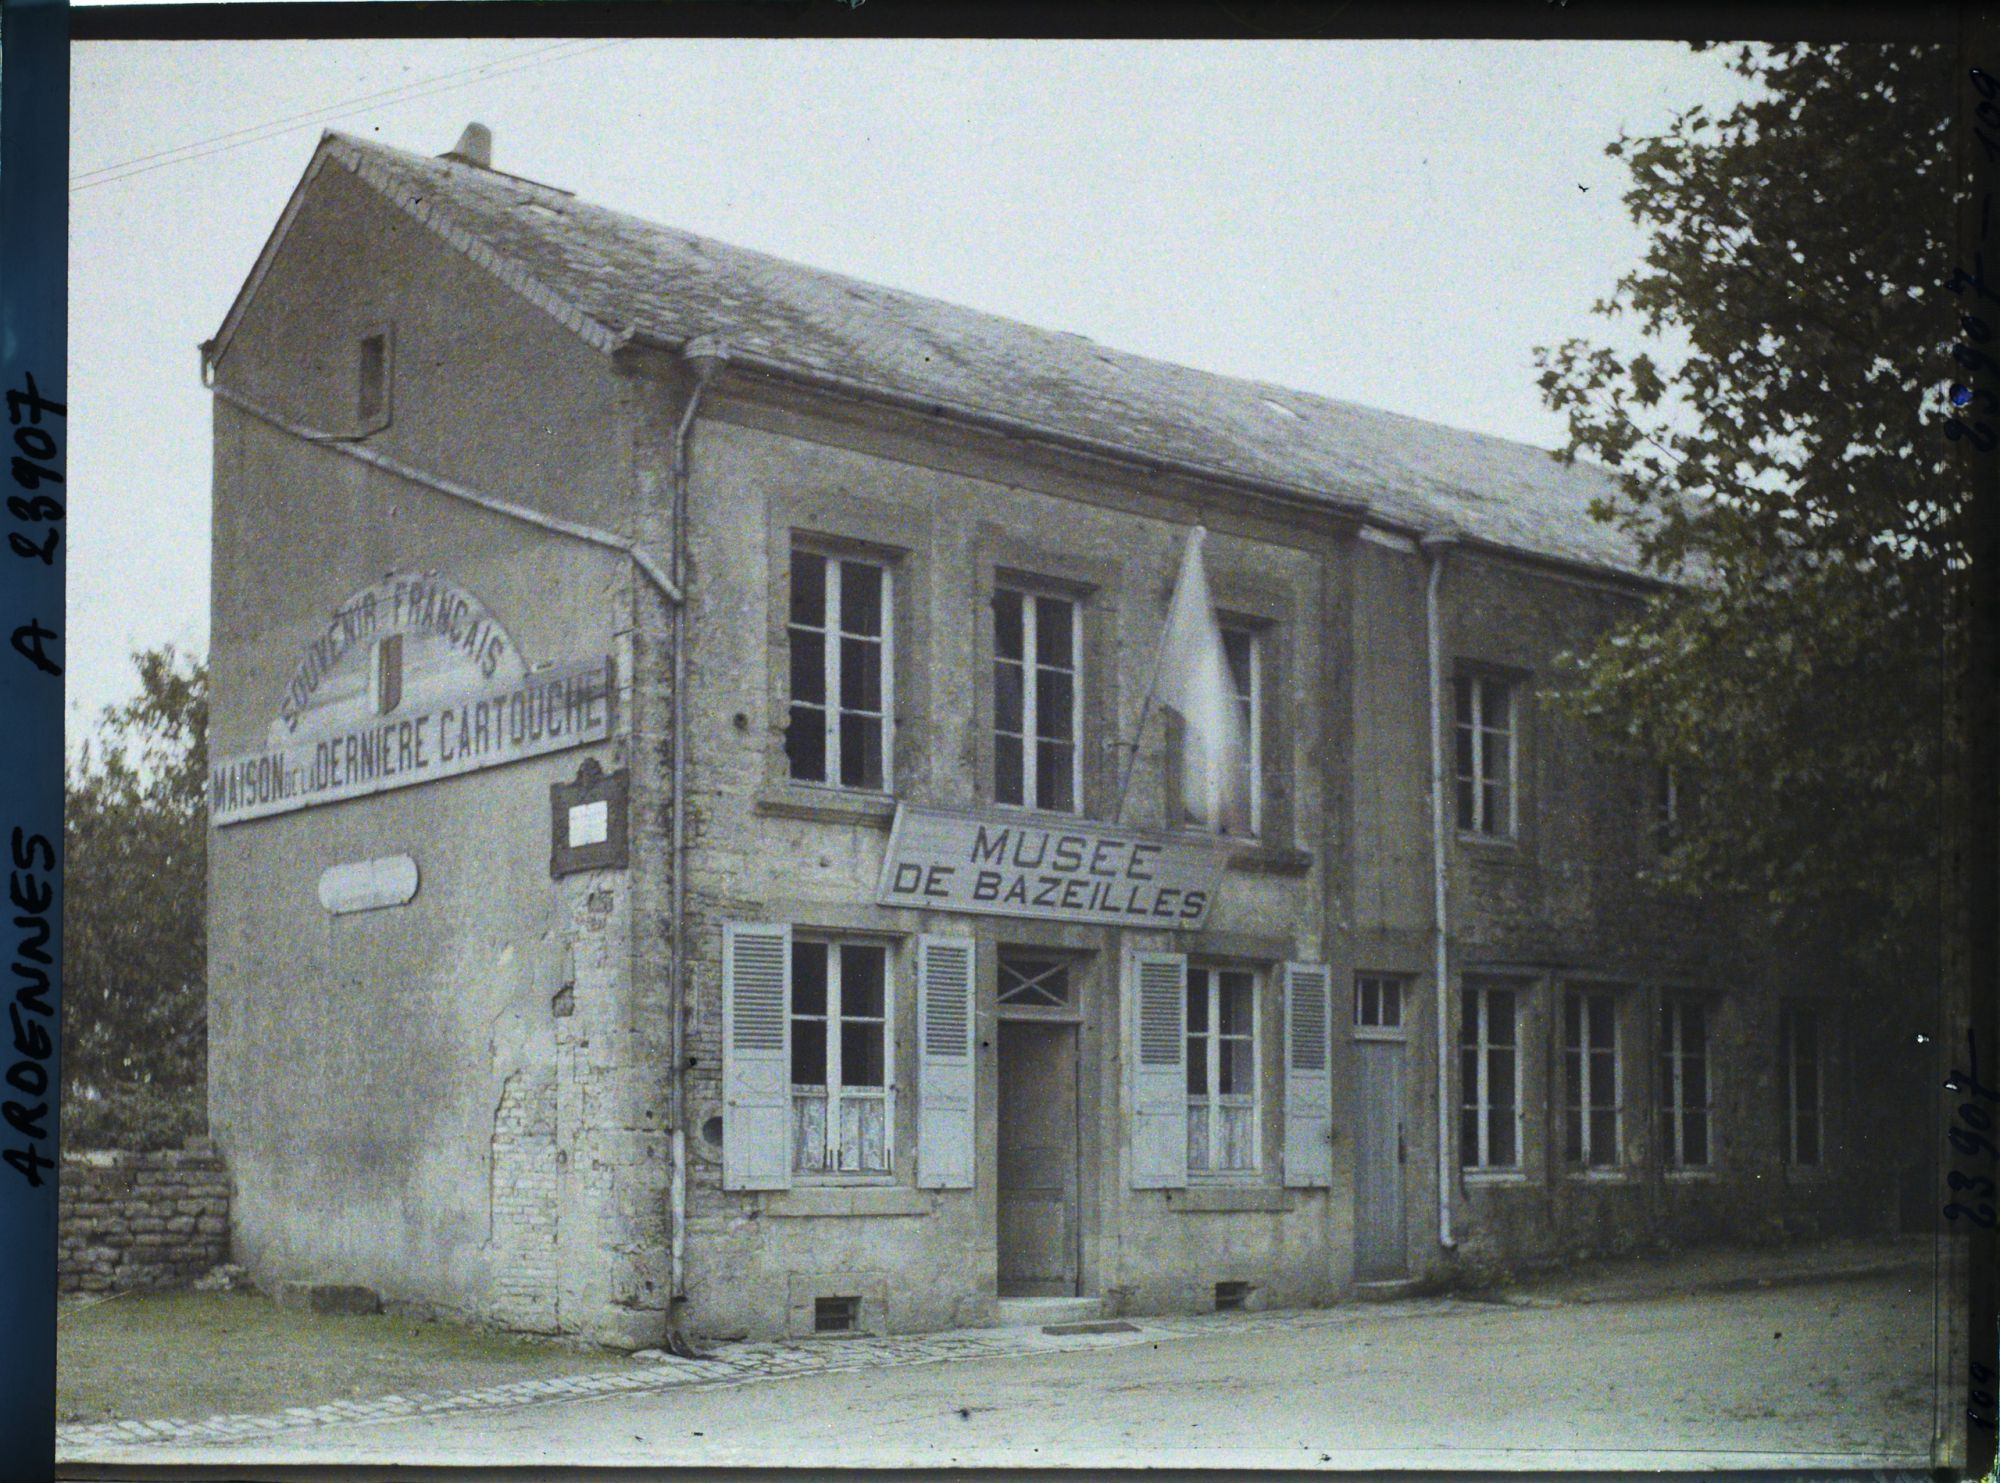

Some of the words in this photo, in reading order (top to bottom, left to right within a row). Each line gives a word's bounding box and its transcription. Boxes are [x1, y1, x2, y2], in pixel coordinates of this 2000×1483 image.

[5, 372, 67, 566] 23907
[12, 618, 62, 677] A
[280, 591, 377, 734] SOUVENIR
[211, 752, 285, 815] MAISON
[440, 674, 602, 762] CARTOUCHE
[893, 862, 956, 897] DE
[973, 870, 1208, 919] BAZEILLES
[3, 826, 54, 1187] ARDENNES
